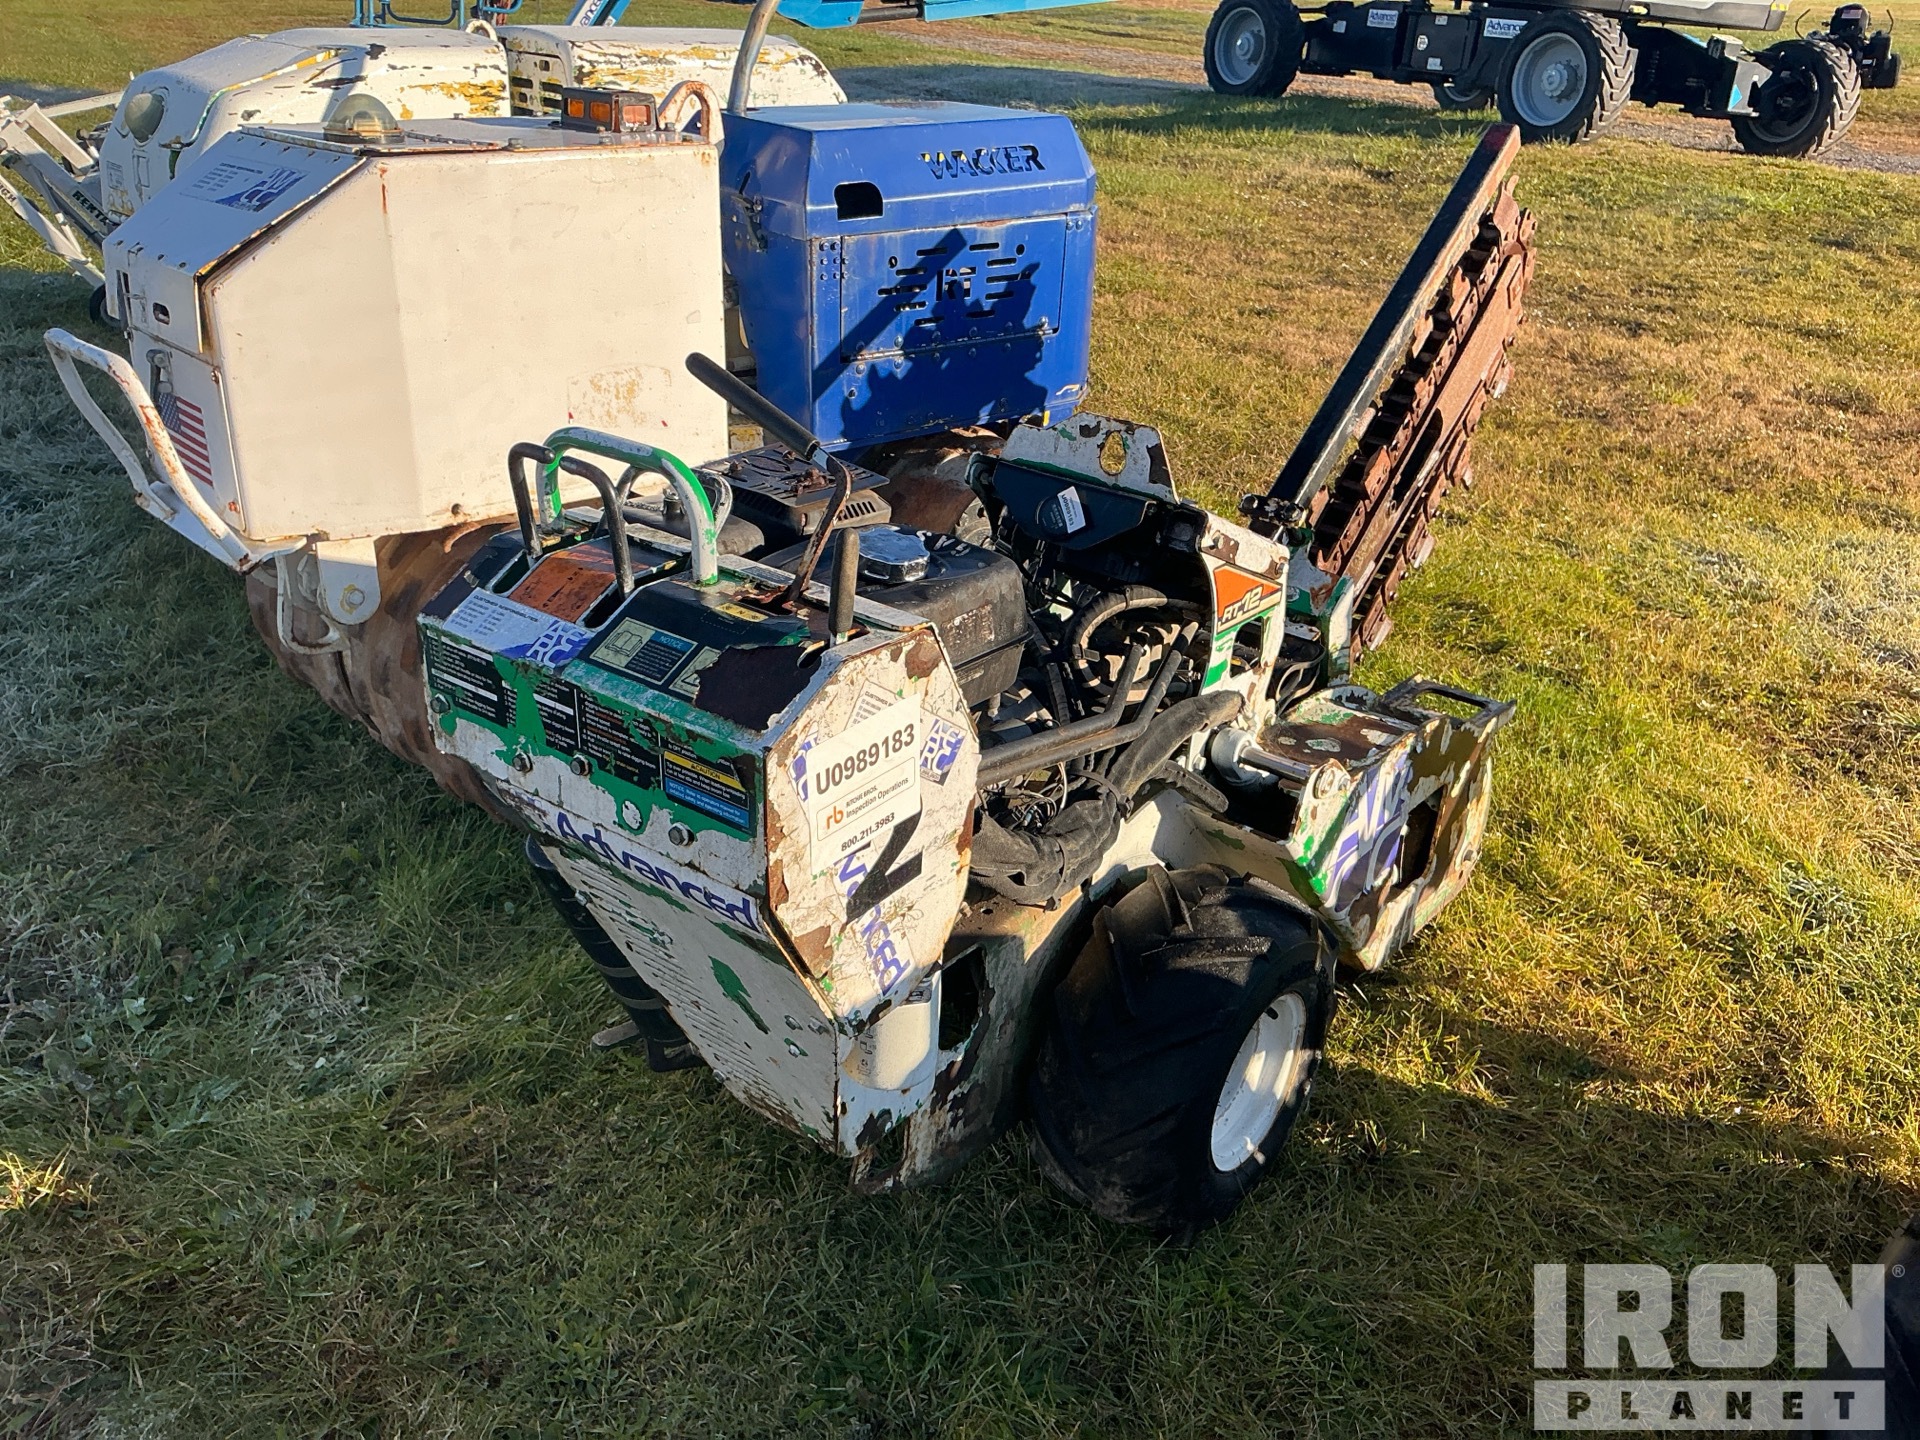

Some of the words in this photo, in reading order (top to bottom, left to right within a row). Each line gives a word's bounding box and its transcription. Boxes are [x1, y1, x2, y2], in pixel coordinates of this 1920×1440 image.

[920, 145, 1046, 180] WACKER
[935, 266, 977, 302] RT
[659, 635, 684, 650] NOTICE
[696, 763, 721, 780] CAUTION
[816, 723, 915, 796] U0989183
[846, 796, 877, 818] Inspection
[877, 778, 909, 800] Operations
[846, 792, 863, 808] RITCHIE
[826, 805, 844, 830] rb
[841, 812, 895, 852] 800.211.3983
[557, 811, 761, 934] Advanced
